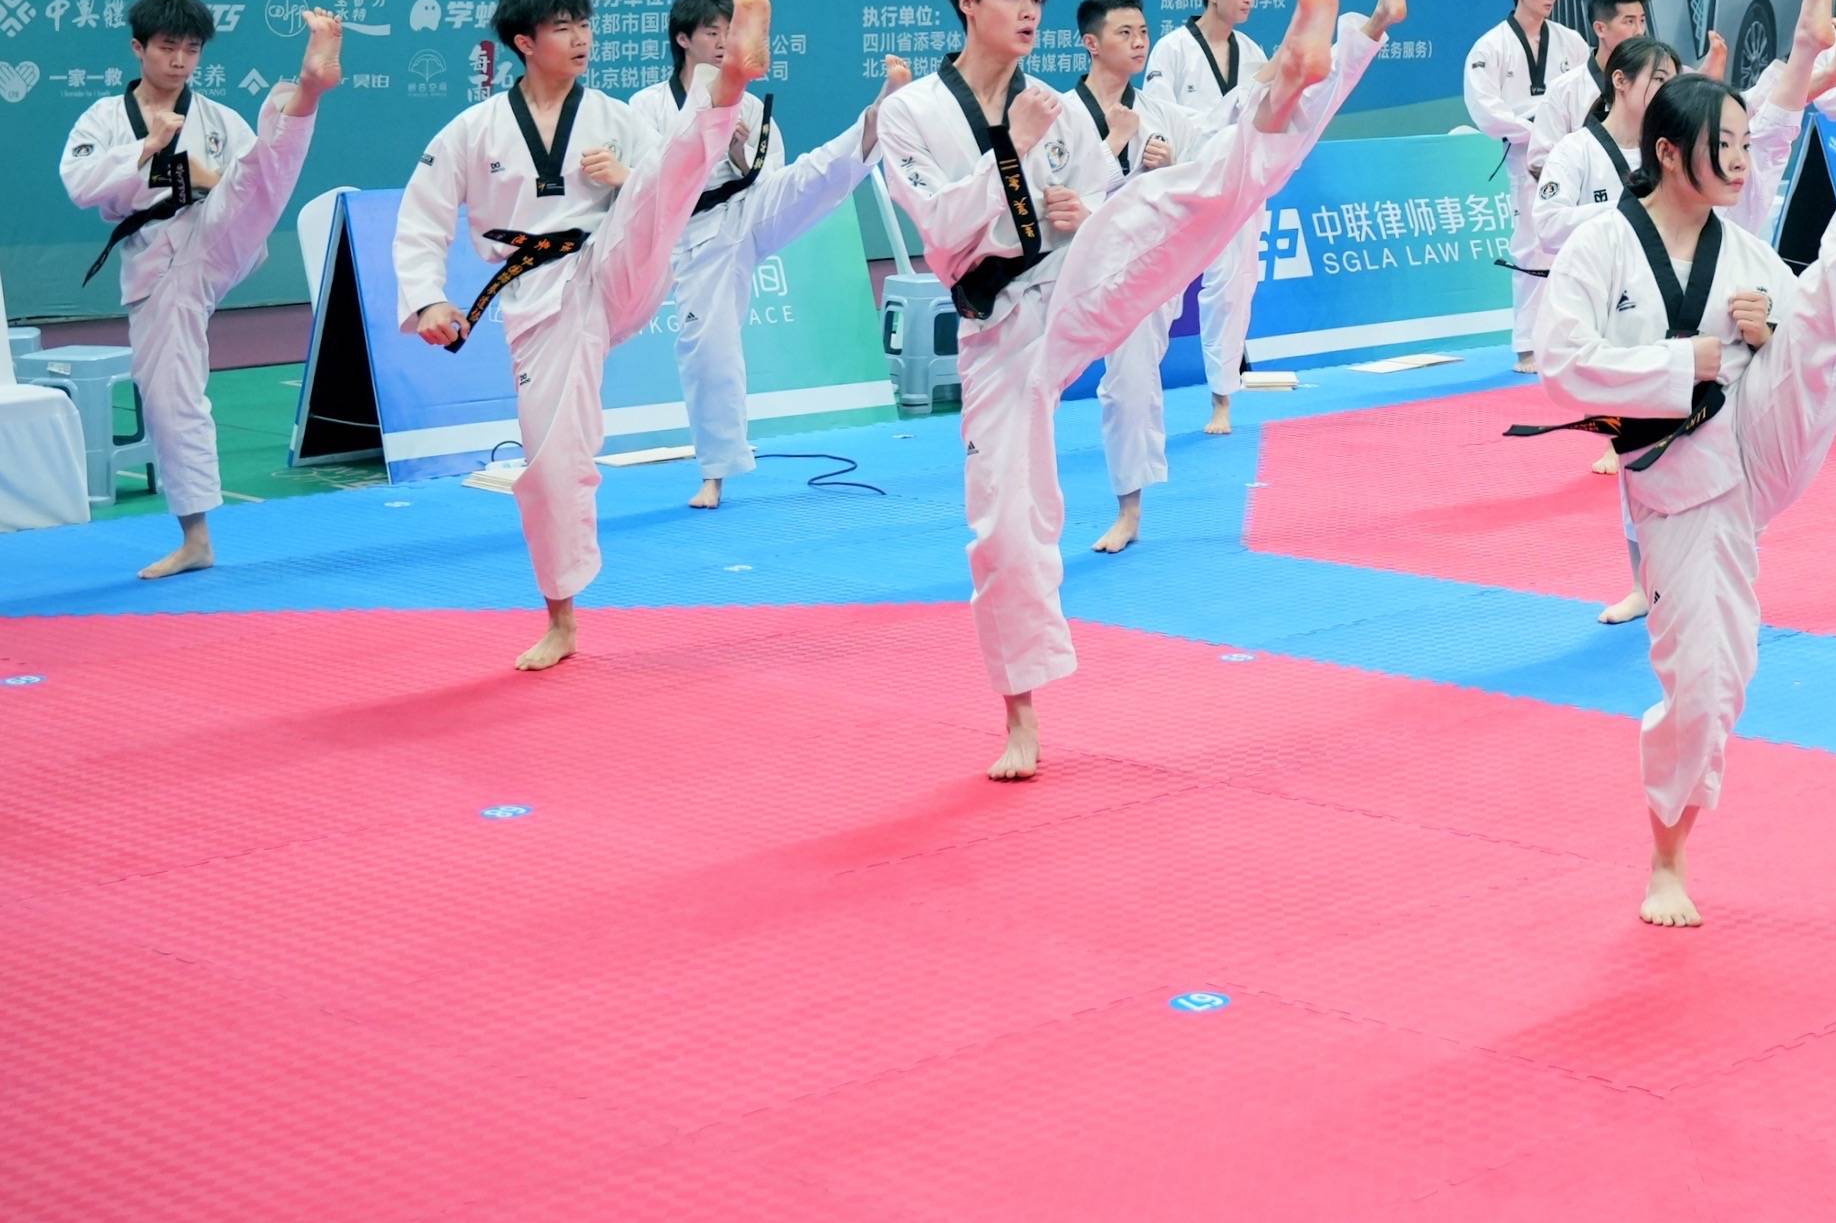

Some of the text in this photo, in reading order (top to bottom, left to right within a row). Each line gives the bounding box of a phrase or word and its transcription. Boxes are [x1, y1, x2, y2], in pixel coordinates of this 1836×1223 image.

[1322, 237, 1514, 275] SGLA LAW FIR
